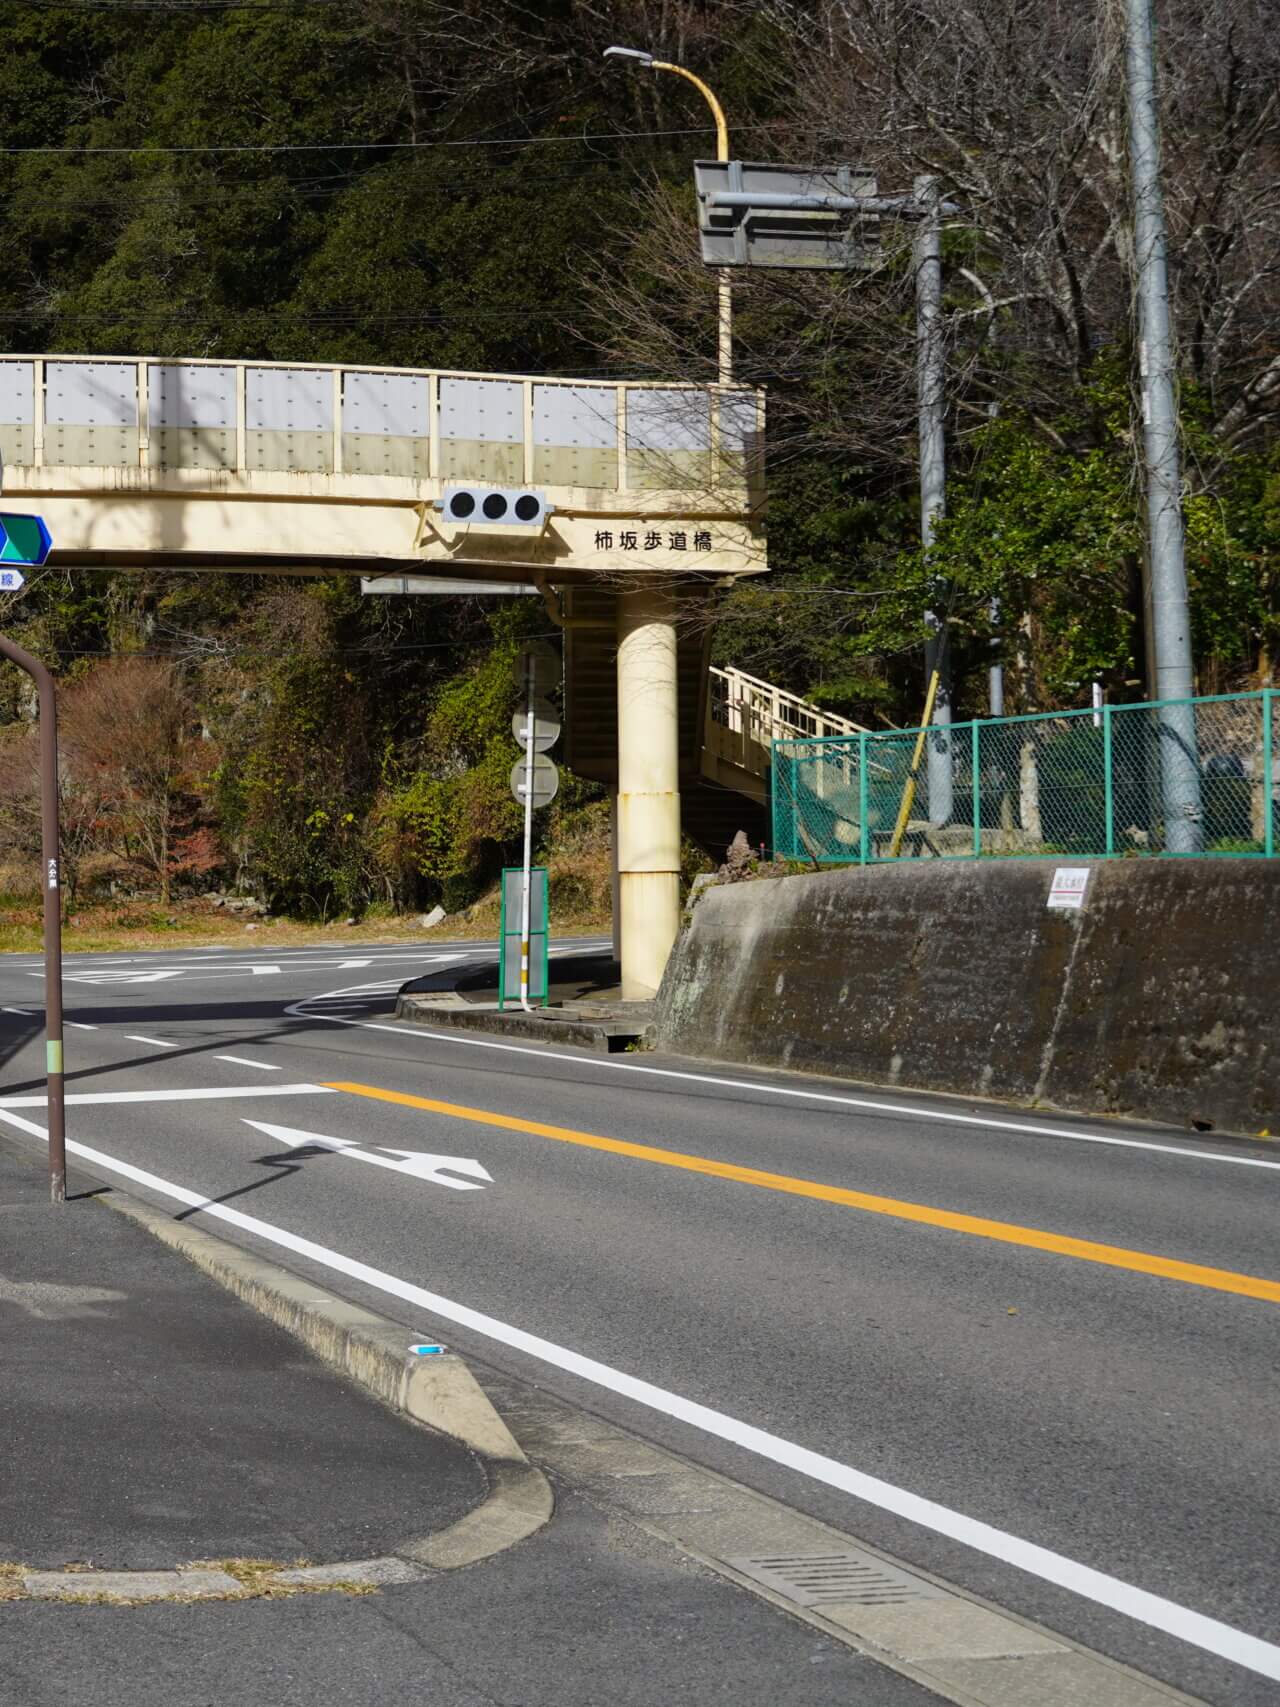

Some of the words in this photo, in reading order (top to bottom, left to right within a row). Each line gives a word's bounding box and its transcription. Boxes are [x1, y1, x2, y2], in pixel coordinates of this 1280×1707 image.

[594, 530, 712, 551] 柿坂歩道橋
